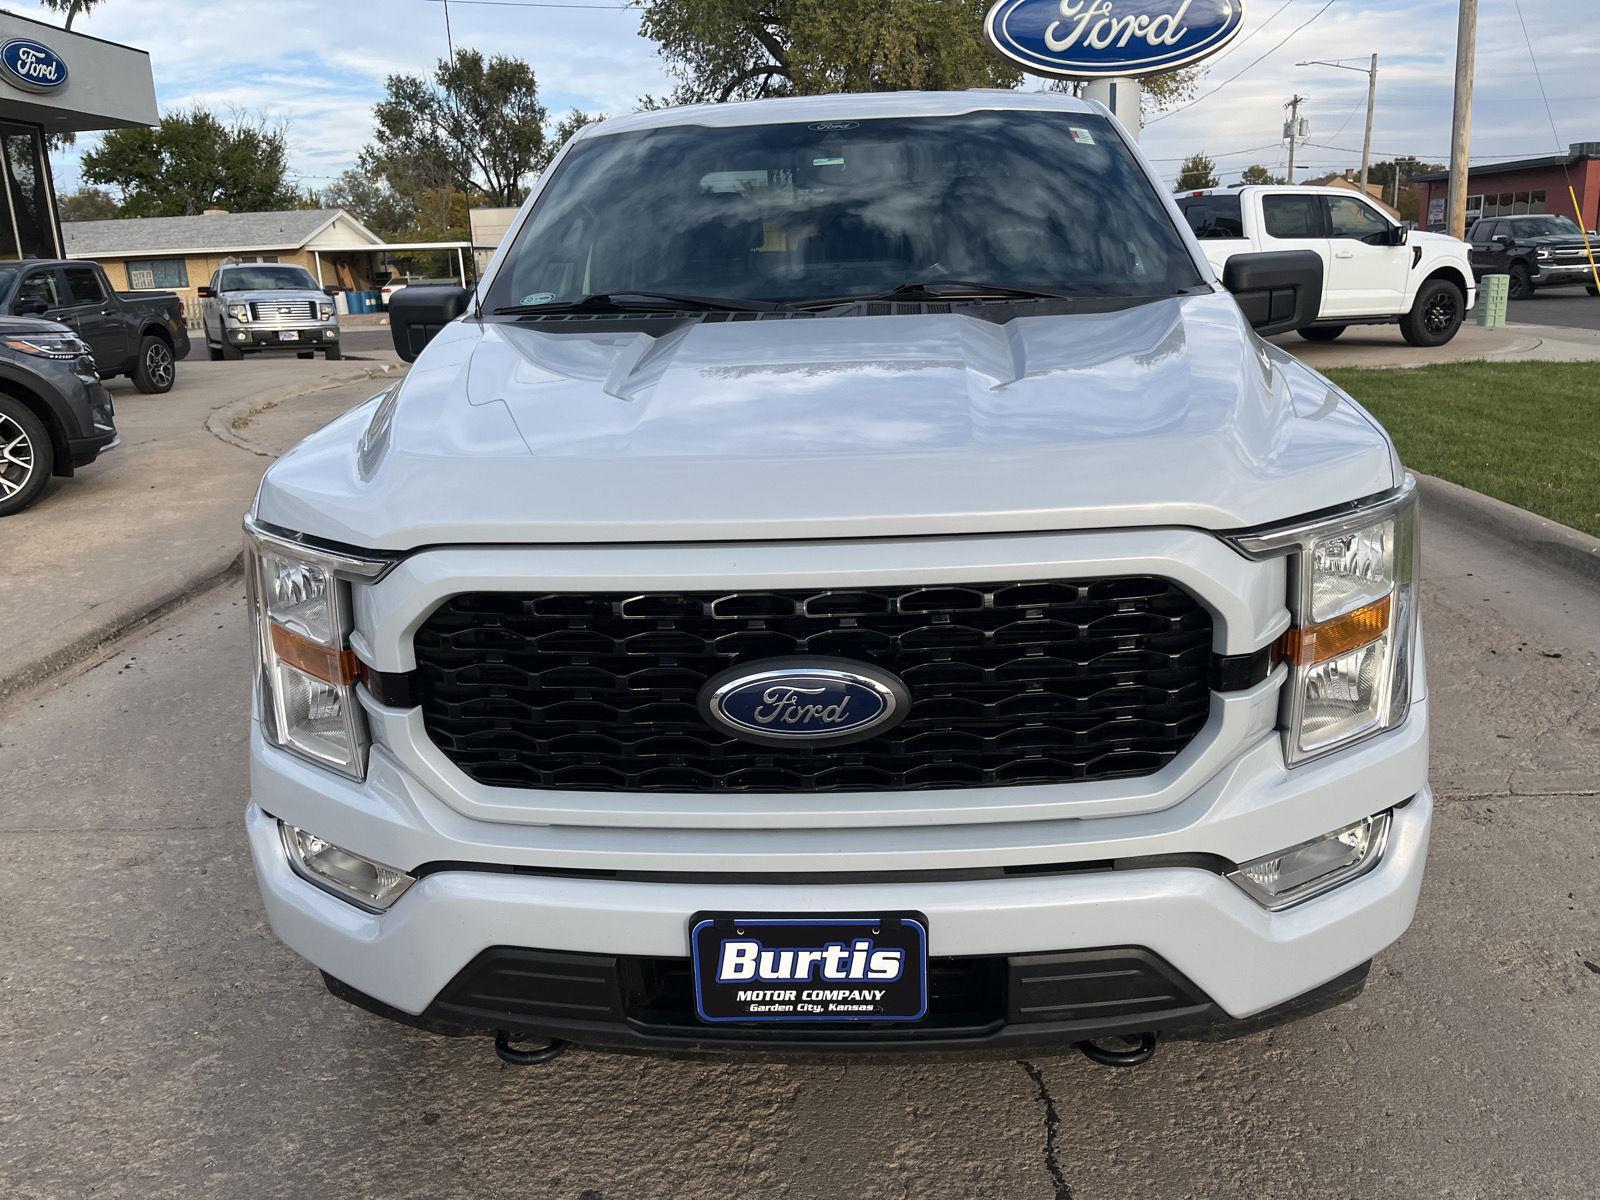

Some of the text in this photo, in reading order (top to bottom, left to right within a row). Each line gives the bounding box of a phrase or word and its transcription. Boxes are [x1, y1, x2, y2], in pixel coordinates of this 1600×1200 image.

[1043, 0, 1191, 52] Ford
[17, 47, 57, 80] Ford
[817, 122, 850, 130] Ford
[753, 685, 851, 724] Ford
[719, 941, 901, 981] Burtis
[736, 990, 886, 1001] MOTOR COMPANY
[749, 1003, 874, 1013] Garden City, Kansas
